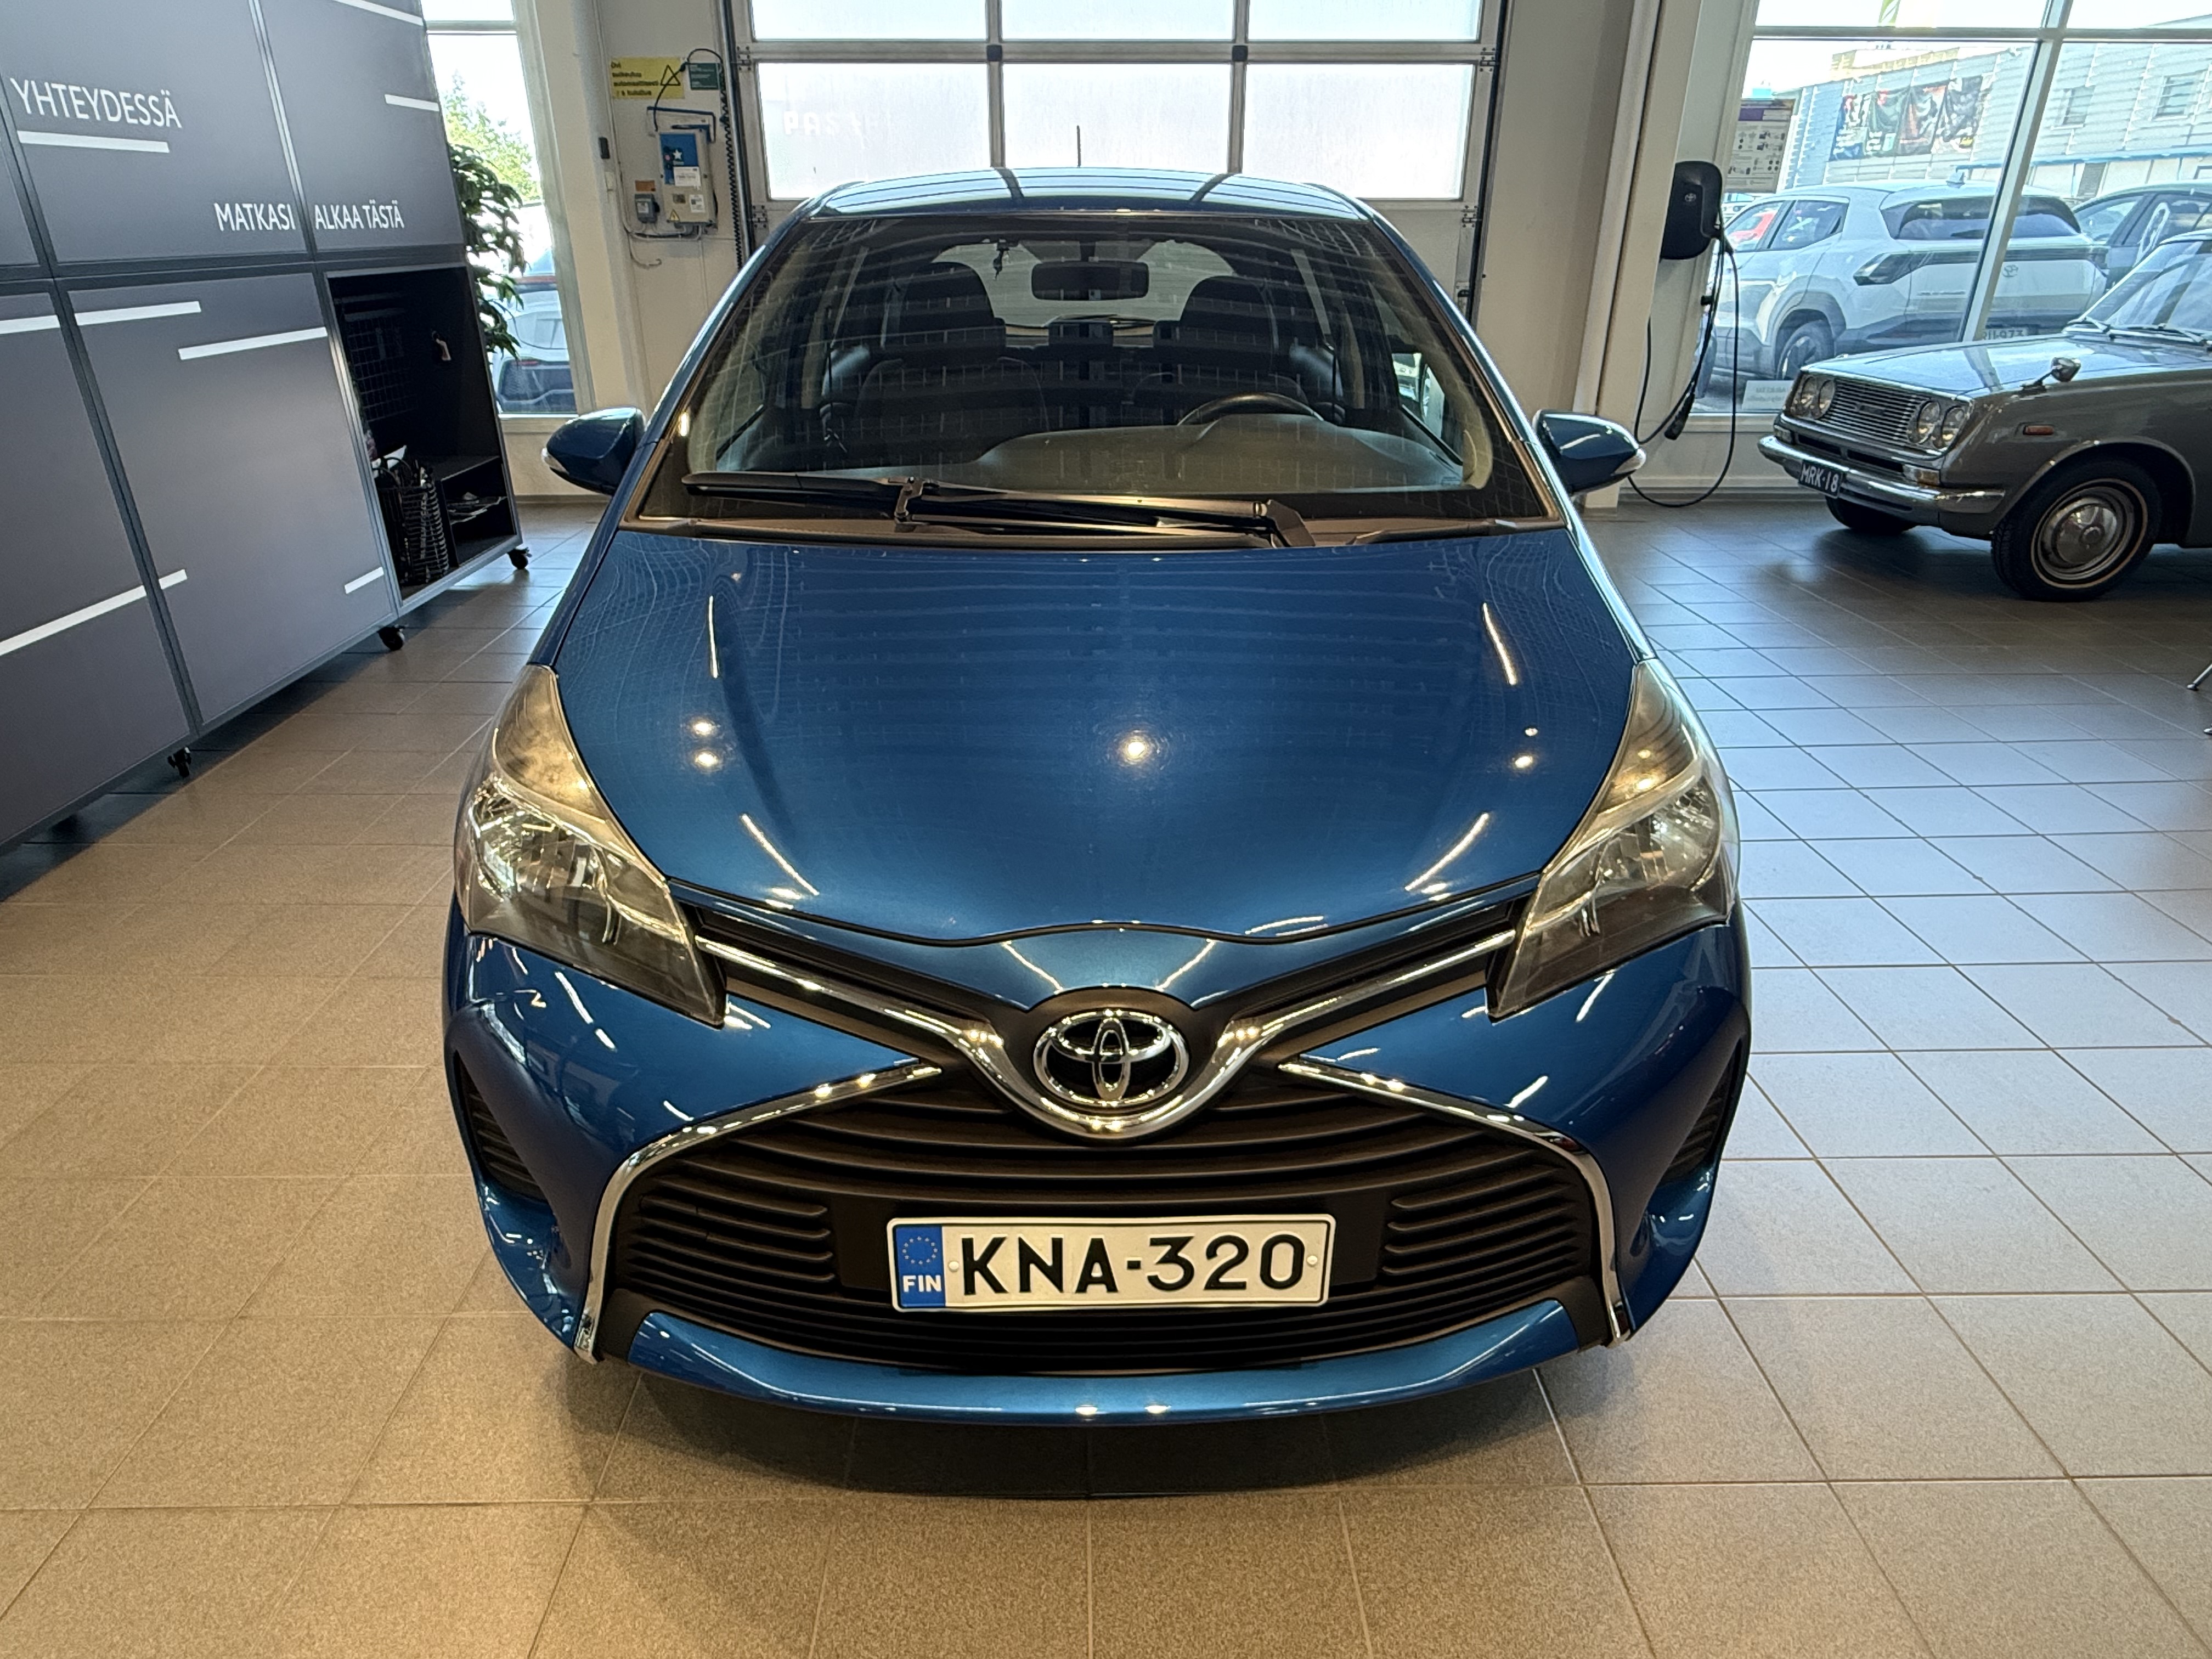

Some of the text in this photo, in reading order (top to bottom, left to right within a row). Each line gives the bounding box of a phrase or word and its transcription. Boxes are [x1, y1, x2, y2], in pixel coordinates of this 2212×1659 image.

[10, 77, 182, 128] YHTEYDESSÄ
[213, 199, 405, 231] MATKASI ALKAA TÄSTÄ
[1800, 463, 1839, 493] MRK-18
[961, 1234, 1306, 1295] KNA-320
[902, 1275, 941, 1293] FIN
